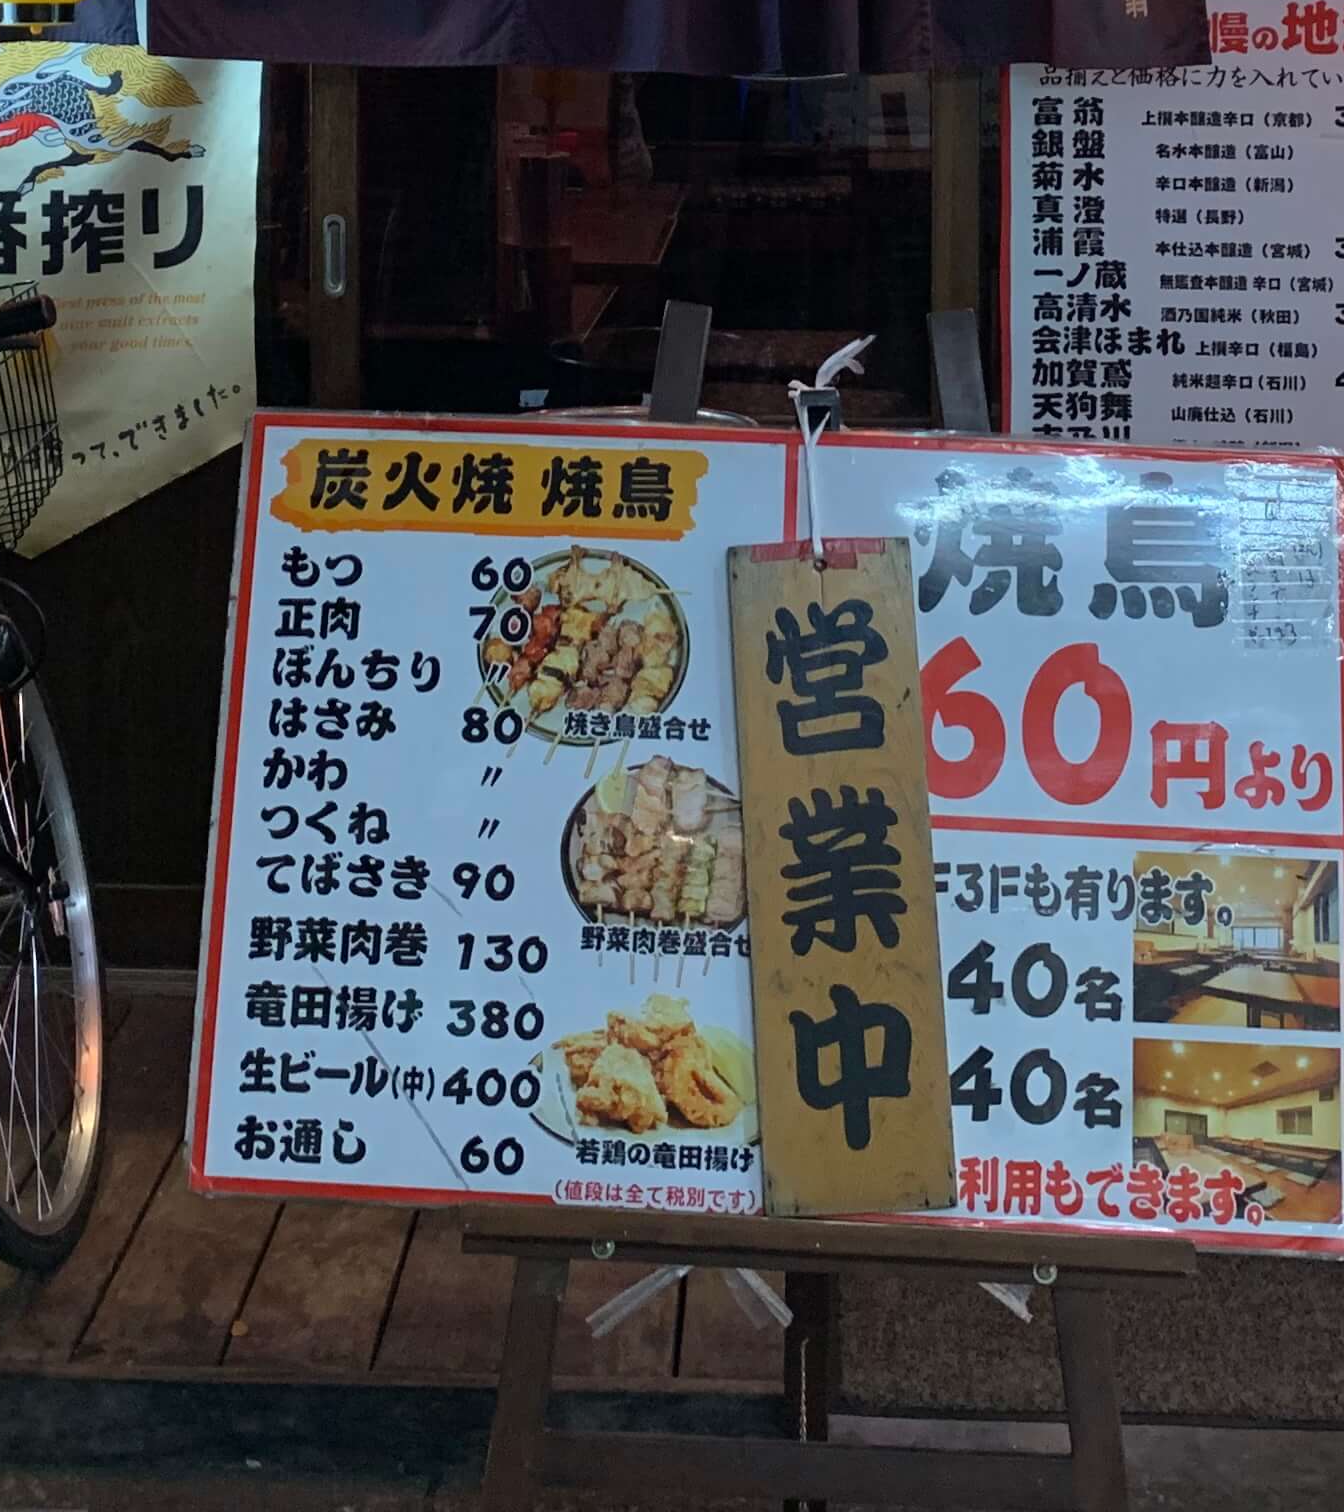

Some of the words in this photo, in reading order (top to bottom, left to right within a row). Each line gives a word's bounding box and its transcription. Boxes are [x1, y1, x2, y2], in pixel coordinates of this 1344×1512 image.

[1033, 96, 1104, 126] 富翁
[1033, 129, 1105, 159] 銀盤
[1033, 162, 1104, 191] 菊水
[1033, 194, 1104, 224] 真澄
[1033, 227, 1104, 257] 浦霞
[1033, 260, 1127, 289] 一ノ蔵
[1032, 293, 1131, 322] 高清水
[1032, 326, 1185, 355] 会津ほまれ
[1032, 358, 1131, 388] 加賀鳶
[1032, 392, 1133, 422] 天狗舞
[310, 447, 514, 515] 炭火焼
[541, 454, 674, 522] 焼鳥
[281, 546, 363, 587] もつ
[471, 555, 533, 592] 60
[914, 464, 1231, 629] 焼鳥
[274, 597, 361, 641] 正肉
[469, 606, 531, 643] 70
[272, 644, 442, 693] ぼんちり
[268, 696, 396, 741] はさみ
[461, 707, 524, 744] 80
[563, 711, 712, 742] 焼き鳥盛合せ
[263, 747, 349, 791] かわ
[260, 801, 391, 845] つくね
[256, 852, 431, 899] てばさき
[452, 862, 516, 902] 90
[765, 597, 912, 1151] 営業中
[249, 915, 429, 967] 野菜肉巻
[457, 933, 549, 974] 130
[580, 924, 752, 958] 野菜肉巻盛合せ
[947, 938, 1123, 1023] 40名
[244, 981, 424, 1033] 竜田揚げ
[446, 1000, 546, 1041] 380
[442, 1067, 541, 1109] 400
[950, 1045, 1124, 1130] 40名
[233, 1114, 368, 1166] お通し
[460, 1136, 526, 1176] 60
[576, 1138, 754, 1174] 若鶏の竜田揚げ
[958, 1155, 1265, 1227] 利用もできます。
